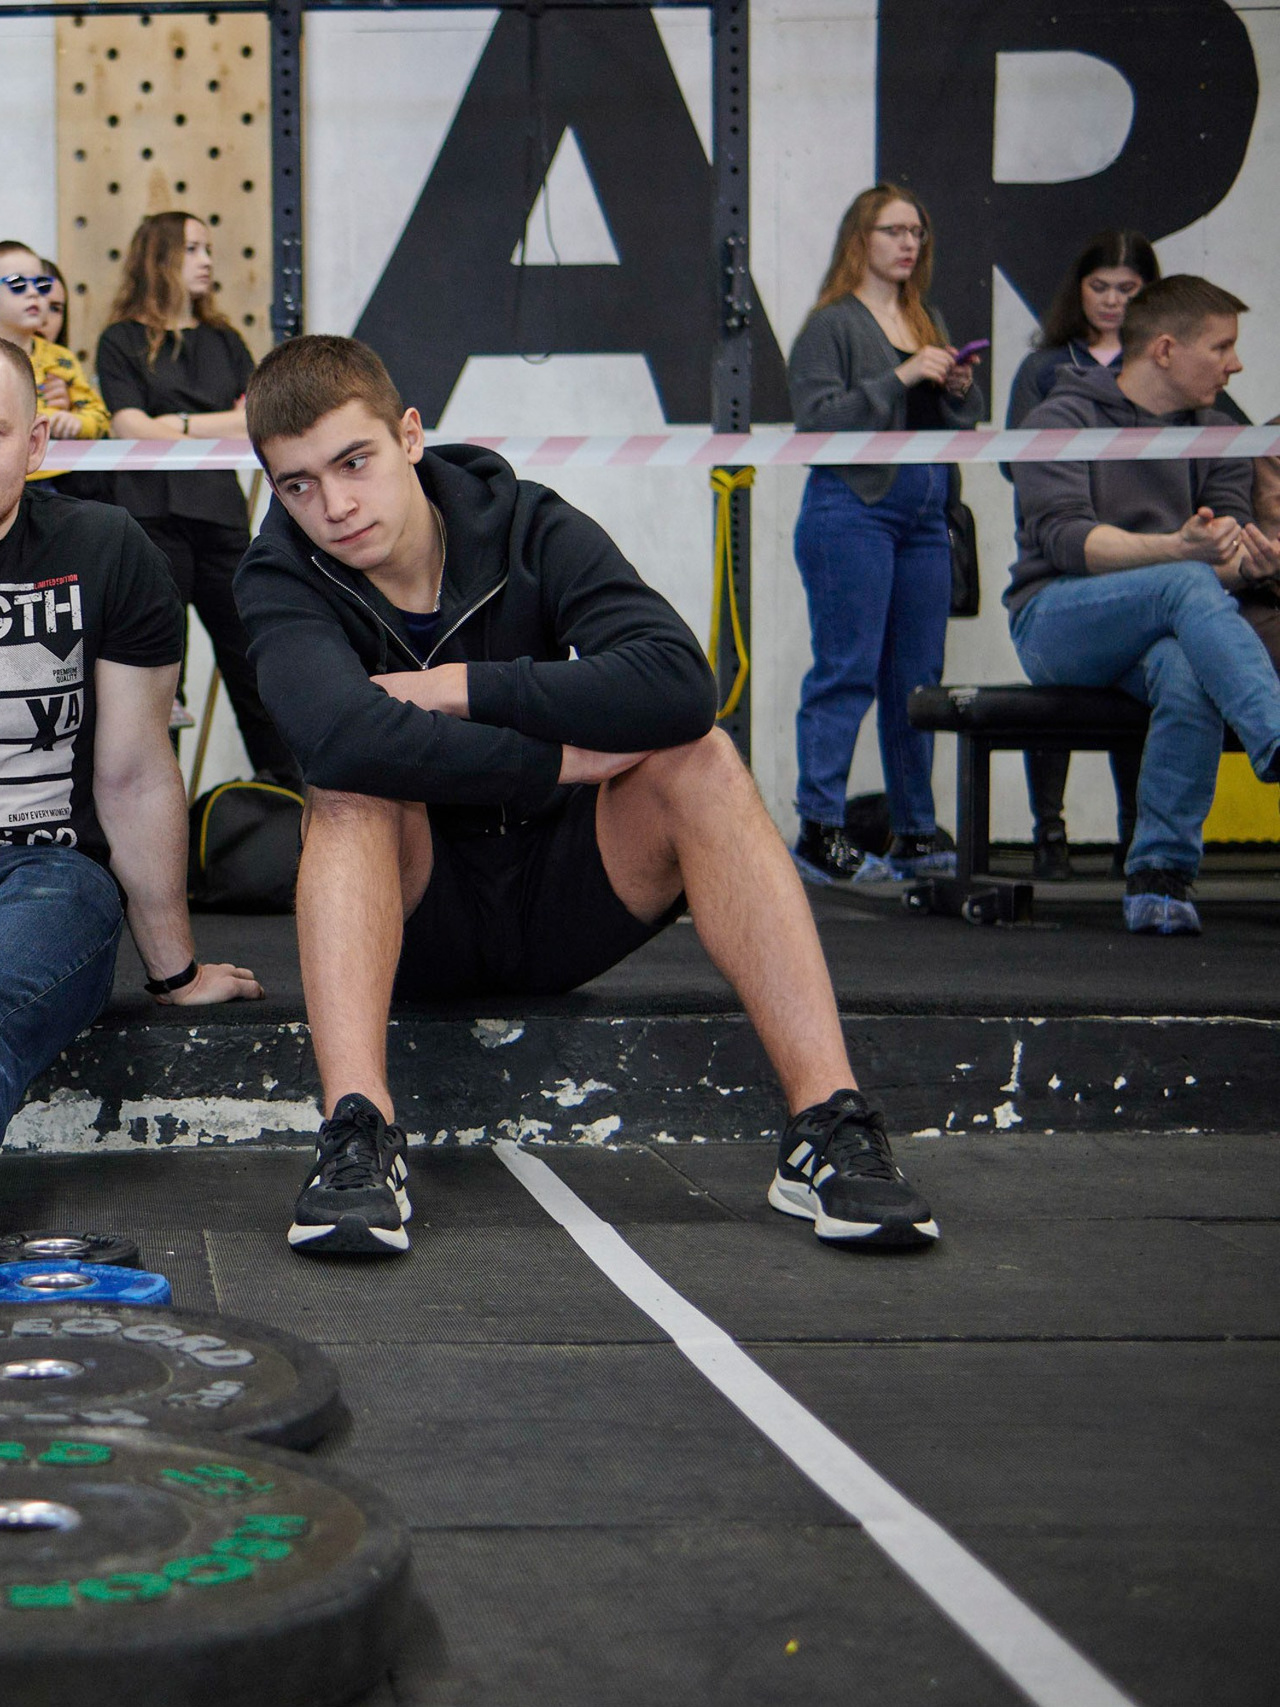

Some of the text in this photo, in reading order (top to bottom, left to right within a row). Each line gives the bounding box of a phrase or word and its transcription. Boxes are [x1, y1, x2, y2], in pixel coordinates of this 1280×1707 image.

[34, 573, 78, 590] LIMITED EDITION
[52, 666, 78, 677] PREMIUM
[55, 674, 77, 683] QUALITY
[8, 807, 70, 823] ENJOY EVERY MOMENT
